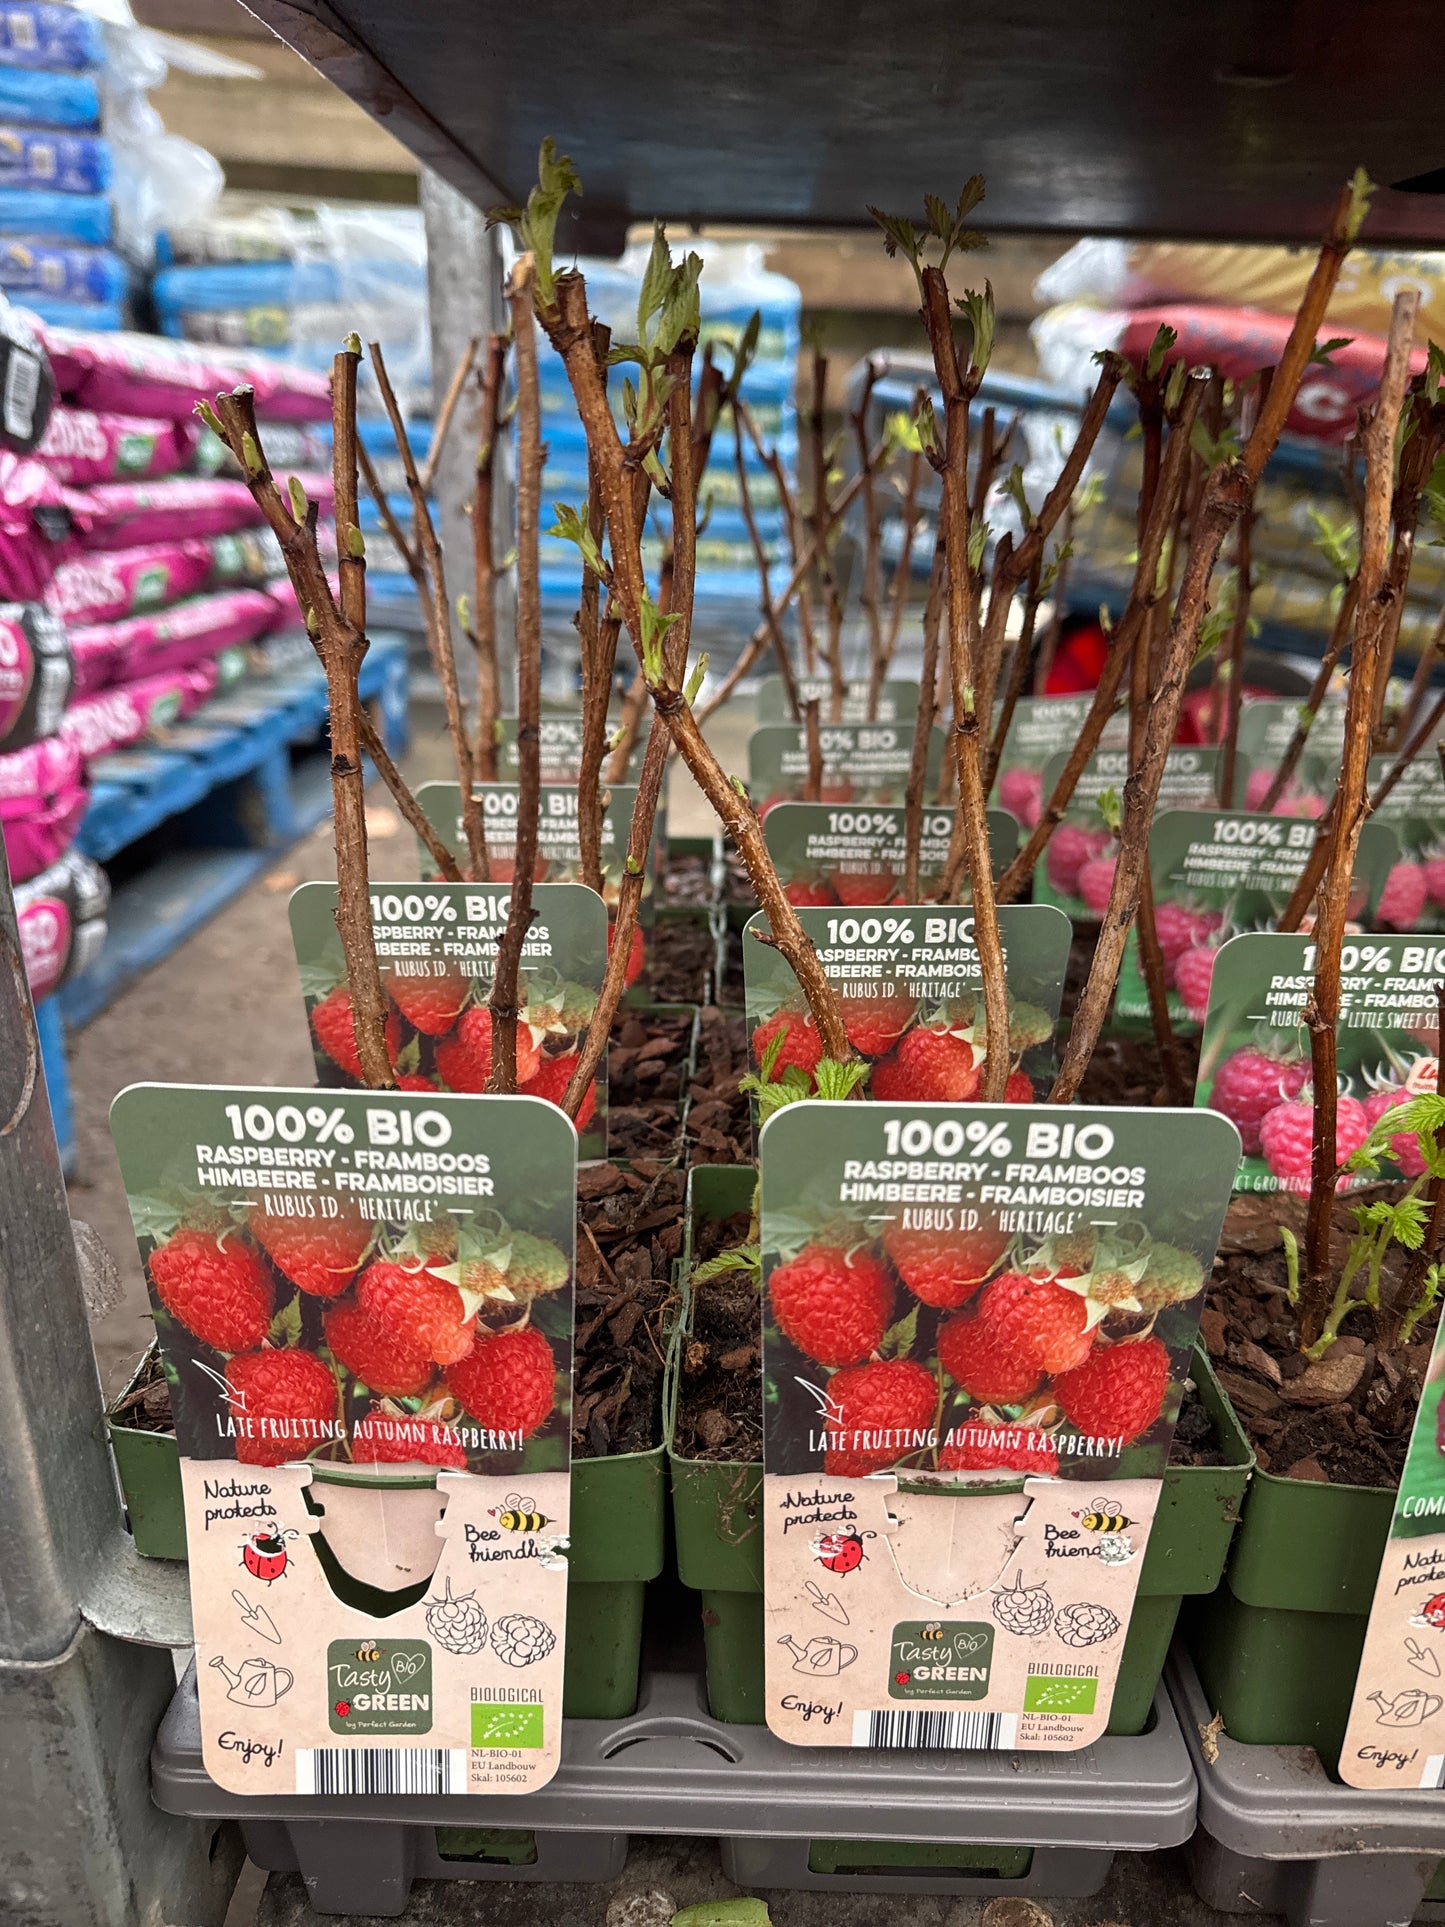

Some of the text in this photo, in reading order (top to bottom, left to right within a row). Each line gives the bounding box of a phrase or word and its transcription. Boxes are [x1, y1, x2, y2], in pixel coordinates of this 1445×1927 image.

[828, 813, 951, 836] 100% IO
[1213, 820, 1317, 848] 100% BI
[808, 835, 886, 848] RASPBERRY
[806, 847, 872, 859] HIMBEERE
[1188, 843, 1266, 859] RASPBERRY
[1274, 848, 1311, 862] FRAM
[1184, 857, 1252, 872] HIMBEERE
[370, 895, 457, 921] 100%
[373, 926, 444, 940] SPBERRY
[457, 926, 549, 940] FRAMOS
[827, 918, 915, 944] 100%
[376, 943, 431, 956] BEERE
[444, 943, 552, 957] FRAMBSIER
[815, 948, 900, 961] ASPBERRY
[1302, 945, 1392, 973] 10%
[395, 961, 497, 977] RUBUS ID. 'HERITA
[842, 982, 966, 998] RUBUS ID. 'HERITAGE'
[1270, 1010, 1303, 1027] RUBU
[1347, 1011, 1384, 1029] LITTLE
[1383, 1012, 1421, 1029] SWEET
[225, 1104, 453, 1148] 100% BIO
[883, 1119, 1115, 1161] 100% BIO
[196, 1144, 336, 1168] RASPBERRY
[354, 1150, 490, 1174] FRAMBOOS
[197, 1167, 317, 1190] HIMBEERE
[334, 1172, 495, 1197] FRAMBOISIER
[843, 1160, 989, 1182] RASPBERRY
[1005, 1163, 1146, 1187] FRAMBOOS
[840, 1183, 963, 1204] HIMBEERE
[980, 1185, 1146, 1209] FRAMBOISIER
[264, 1194, 439, 1222] RUBUS ID. 'HERITAGE'
[902, 1207, 1083, 1234] RUBUS ID. 'HERITAGE'
[216, 1413, 524, 1452] LATE FRUITING AUTUMN RASPBERRY!
[808, 1428, 1124, 1458] LATE FRUITING AUTUMN RASPBERRY!
[204, 1478, 272, 1499] Nature
[783, 1489, 856, 1509] Nature
[1402, 1495, 1445, 1519] COM
[204, 1498, 277, 1531] protects
[783, 1504, 858, 1534] protects
[464, 1523, 501, 1543] Bee
[1044, 1524, 1081, 1541] Bee
[958, 1637, 979, 1649] BIO
[894, 1641, 953, 1667] Tasty
[396, 1660, 417, 1675] BIO
[913, 1666, 987, 1682] GREEN
[1028, 1662, 1099, 1677] BIOLOGICAL
[329, 1664, 393, 1695] Tasty
[353, 1693, 429, 1711] GREEN
[470, 1687, 544, 1703] BIOLOGICAL
[904, 1688, 914, 1696] by
[780, 1695, 843, 1725] Enjoy!
[1022, 1713, 1072, 1722] NL-BIO-01
[346, 1721, 356, 1730] by
[1038, 1724, 1084, 1733] Landbouw
[1019, 1733, 1074, 1742] Skal: 105602
[217, 1731, 284, 1767] Enjoy!
[471, 1750, 522, 1759] NL-BIO-01
[1357, 1745, 1419, 1769] Enjoy!
[471, 1761, 537, 1771] EU Landbouw
[471, 1773, 528, 1783] Skal: 105602
